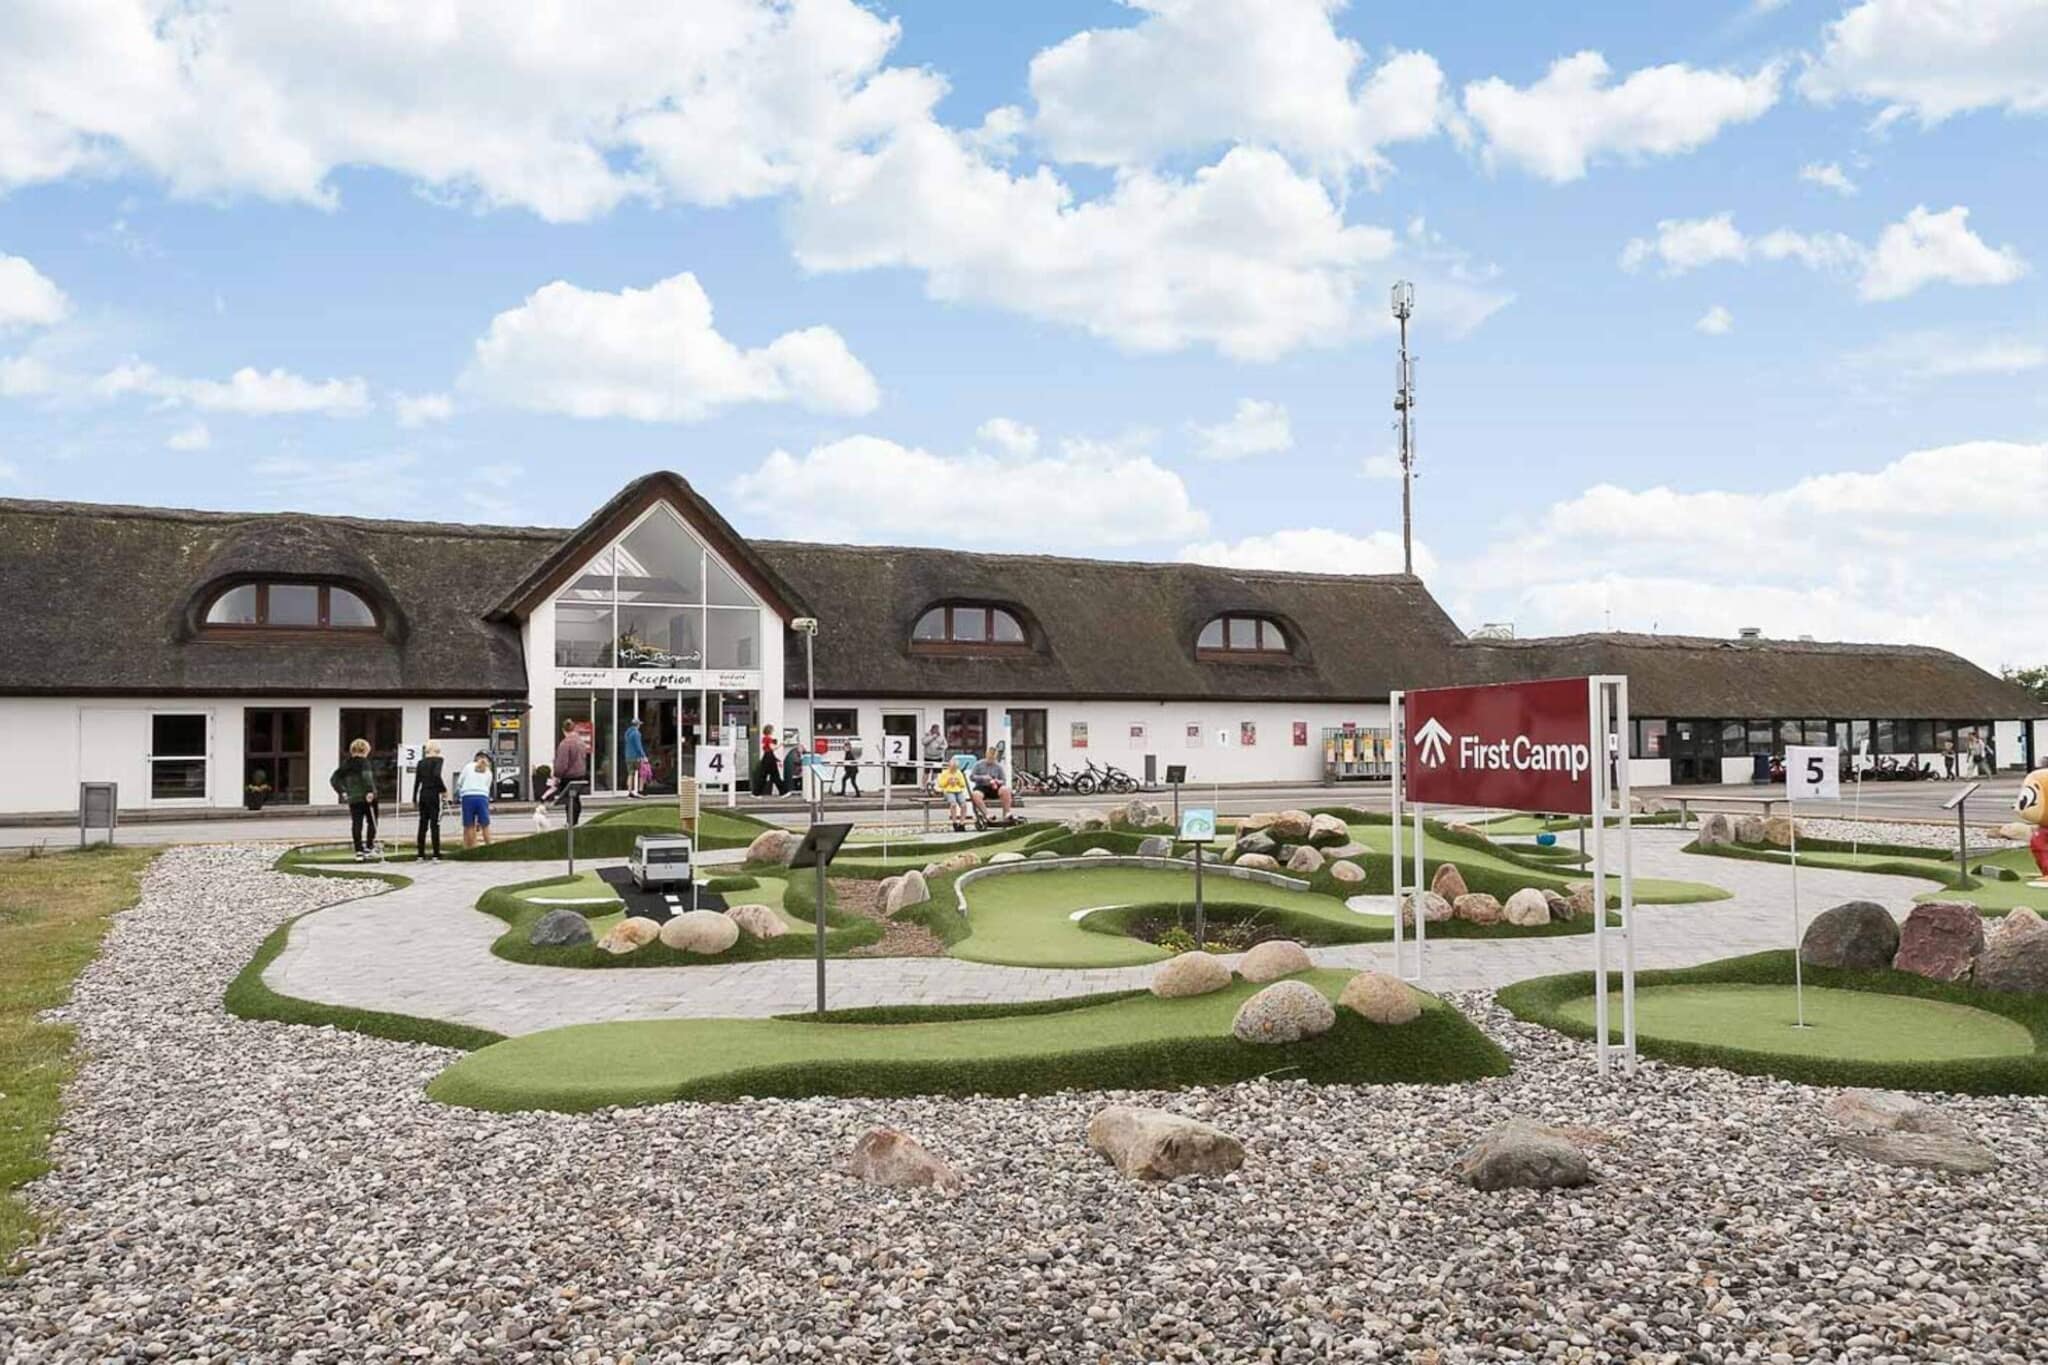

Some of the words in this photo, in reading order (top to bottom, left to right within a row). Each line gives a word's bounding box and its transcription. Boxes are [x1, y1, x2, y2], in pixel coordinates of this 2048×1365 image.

[628, 671, 692, 687] Reception
[406, 748, 416, 761] 3
[893, 740, 903, 754] 2
[708, 753, 724, 773] 4
[1807, 757, 1825, 784] 5
